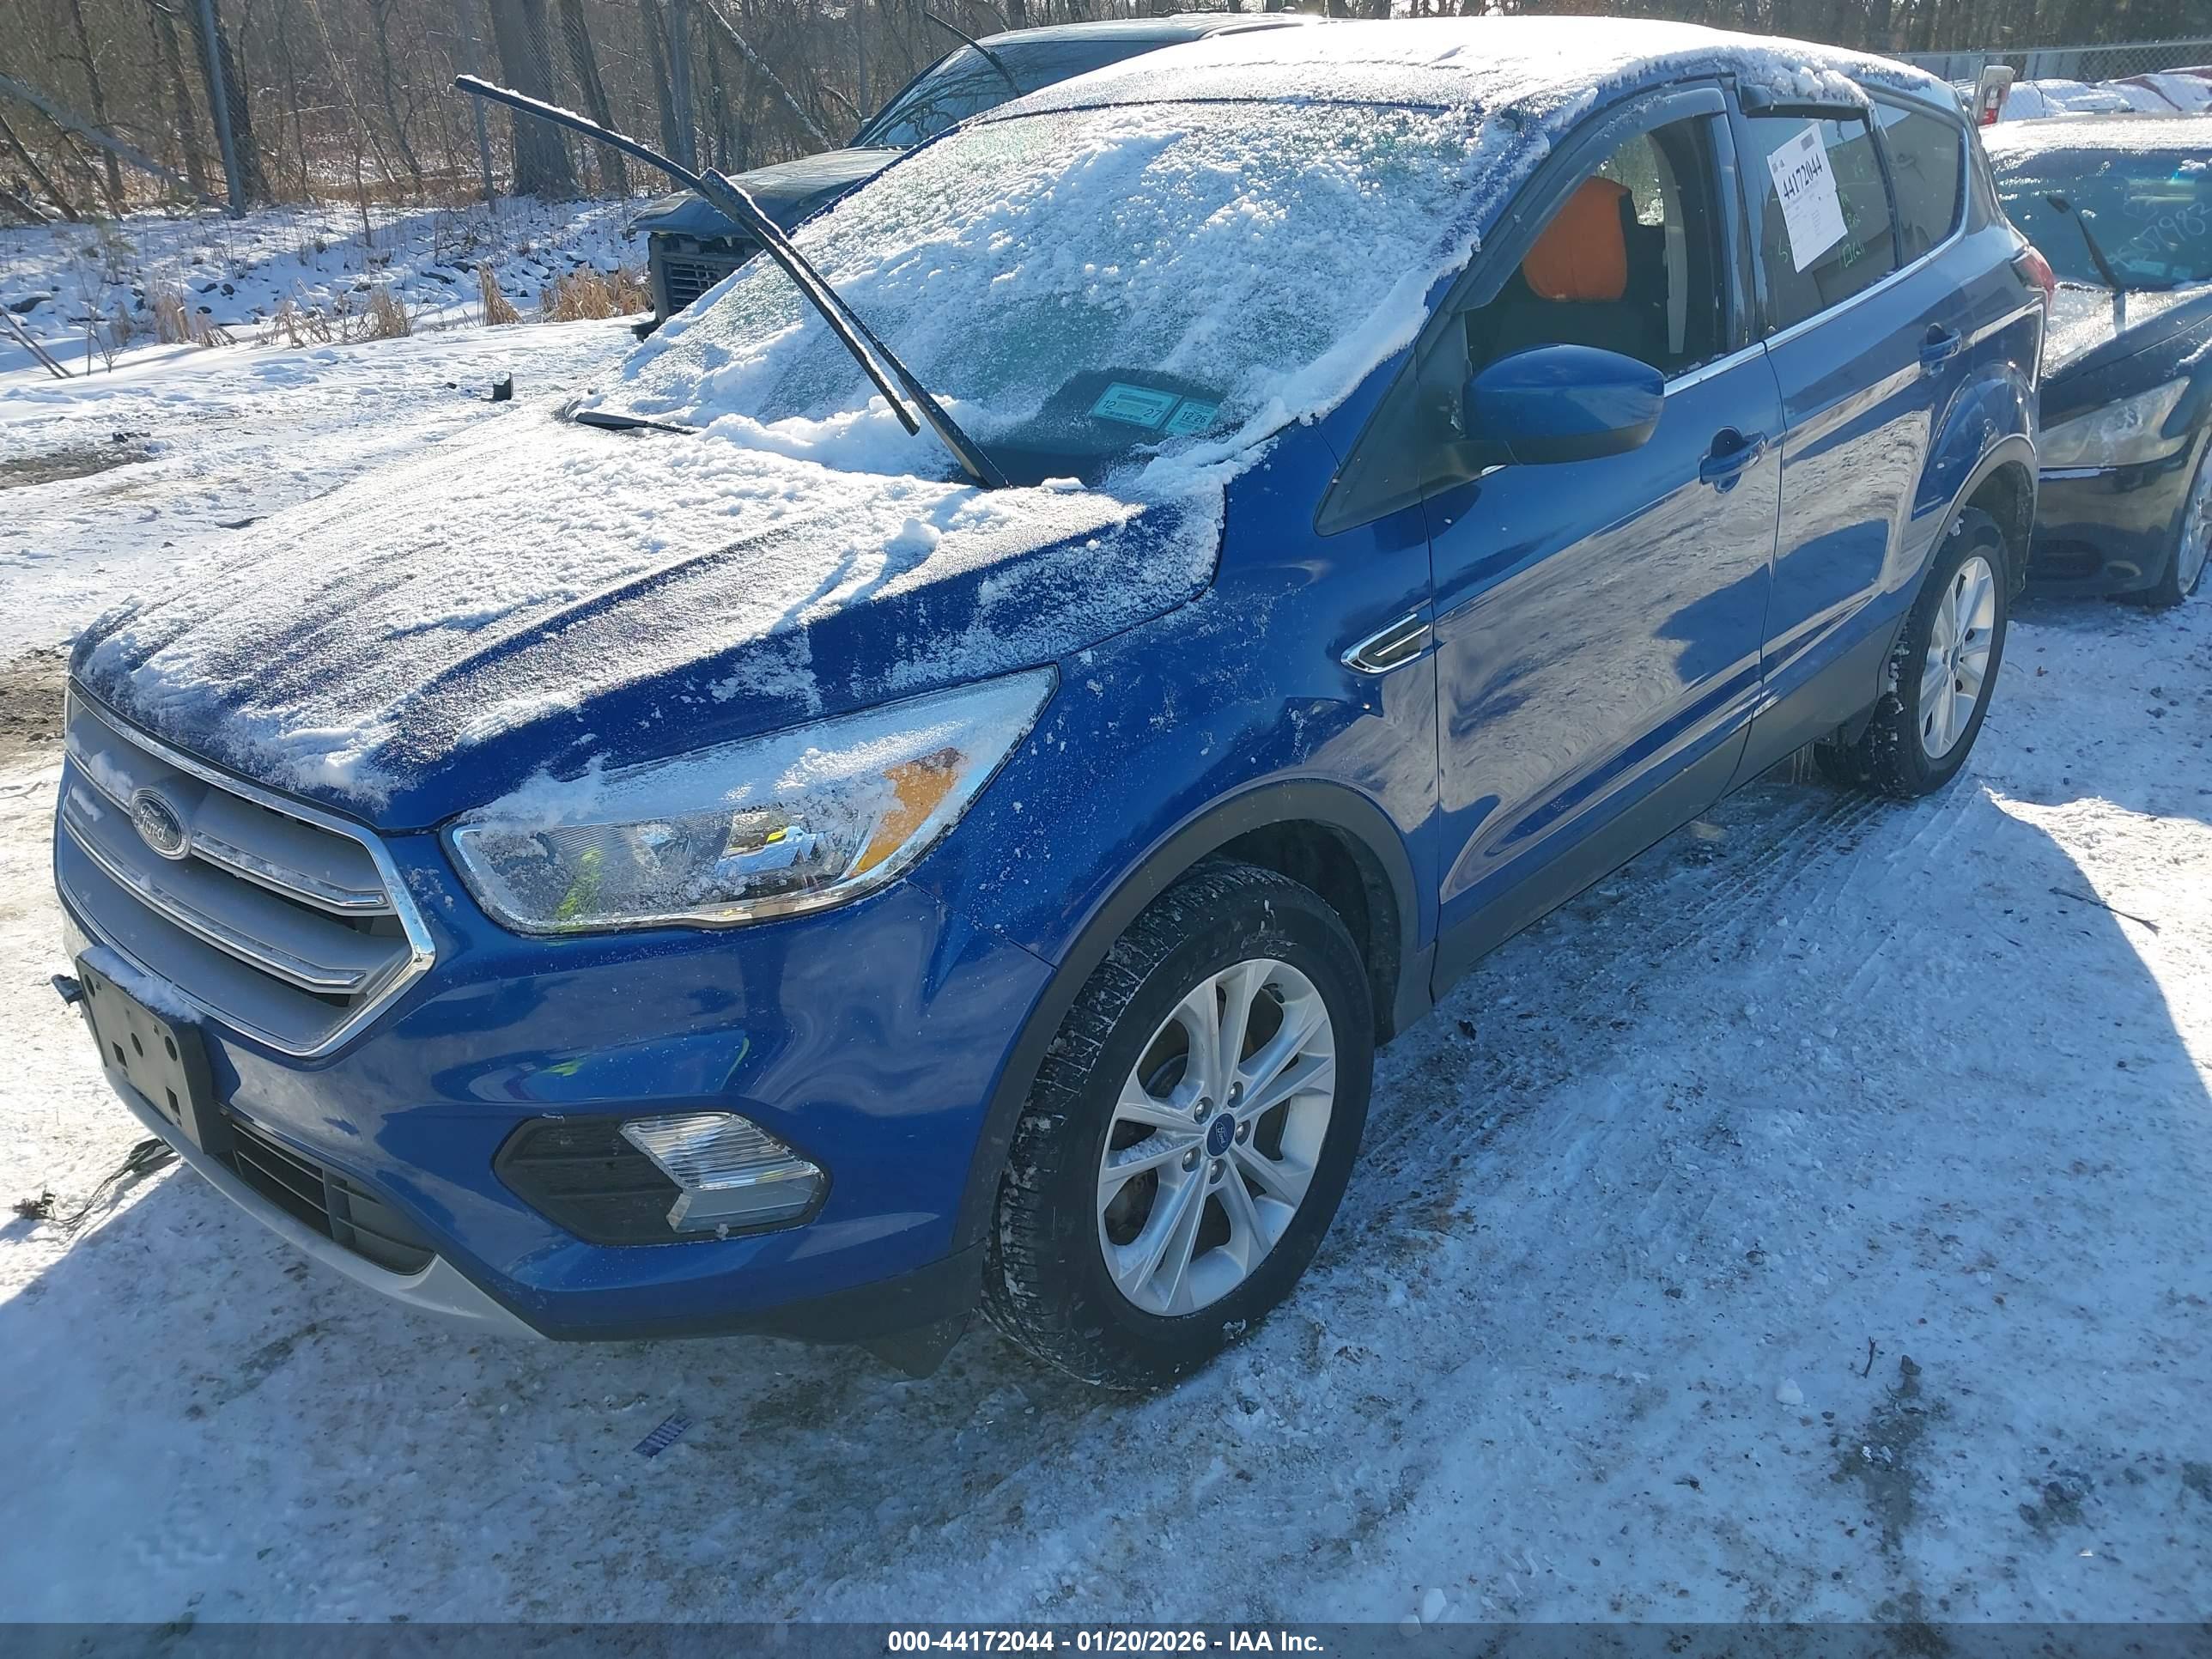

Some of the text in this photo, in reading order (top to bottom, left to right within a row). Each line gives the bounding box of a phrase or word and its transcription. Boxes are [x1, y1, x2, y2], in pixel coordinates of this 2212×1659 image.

[1784, 153, 1823, 200] 44172044
[1143, 408, 1164, 419] 27
[137, 803, 167, 843] Ford
